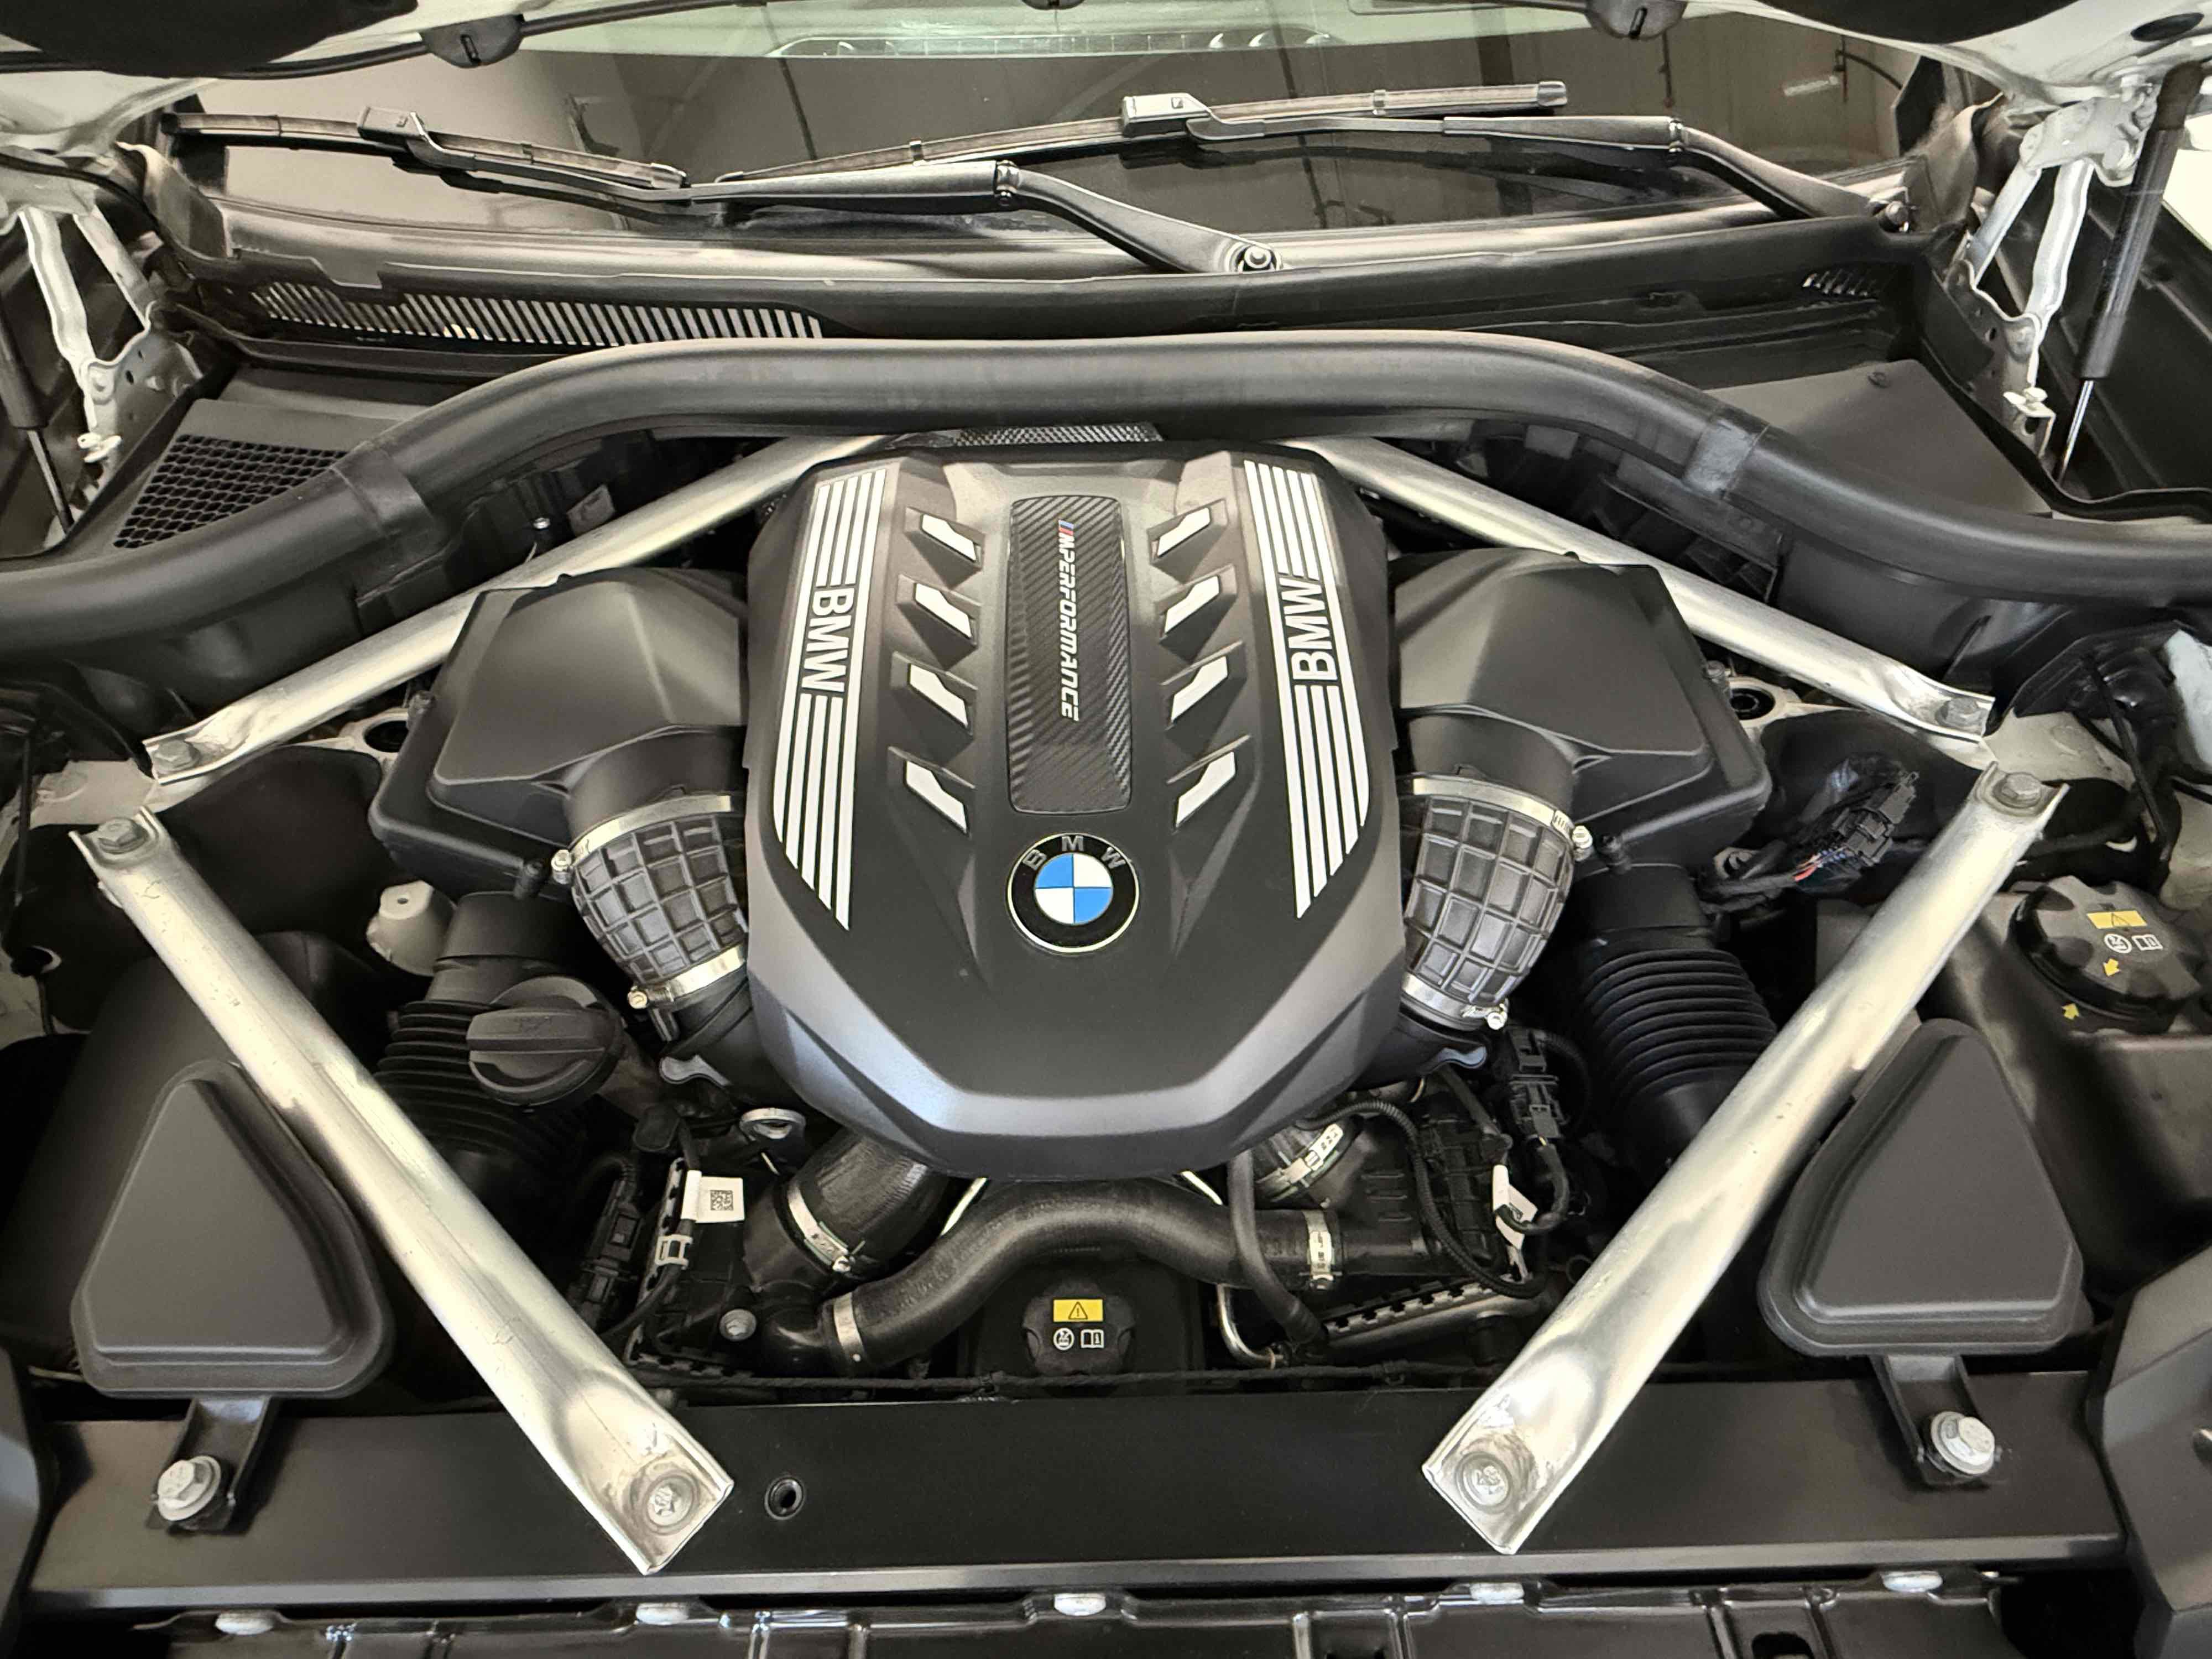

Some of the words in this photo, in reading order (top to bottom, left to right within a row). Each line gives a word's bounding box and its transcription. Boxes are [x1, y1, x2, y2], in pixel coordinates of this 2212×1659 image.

[801, 588, 855, 693] BMW
[1278, 577, 1338, 680] BMW
[1022, 835, 1126, 870] BMW
